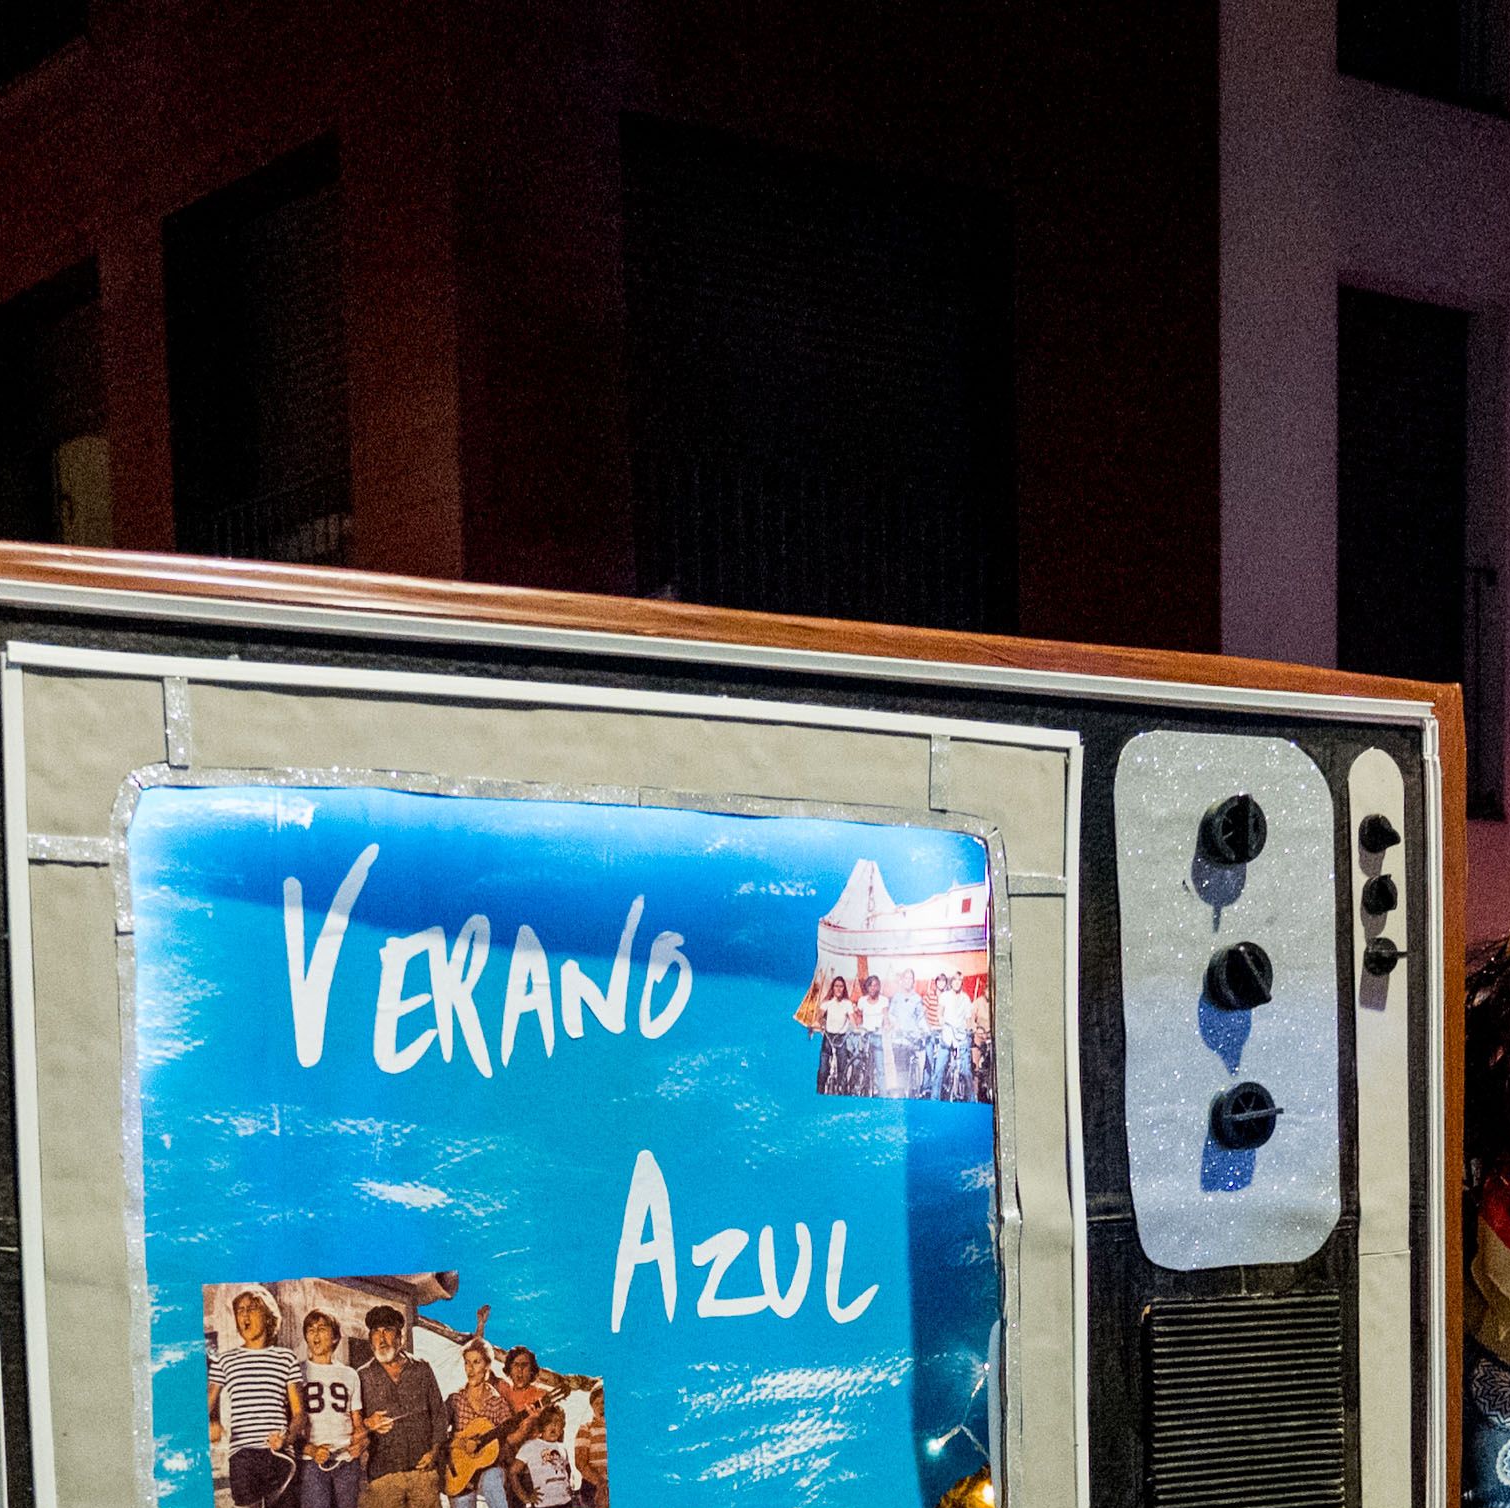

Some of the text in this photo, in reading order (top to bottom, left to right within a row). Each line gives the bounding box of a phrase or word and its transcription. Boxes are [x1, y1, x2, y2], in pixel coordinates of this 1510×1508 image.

[283, 842, 693, 1079] VERANO
[610, 1149, 880, 1333] AZUL
[303, 1381, 349, 1414] 89
